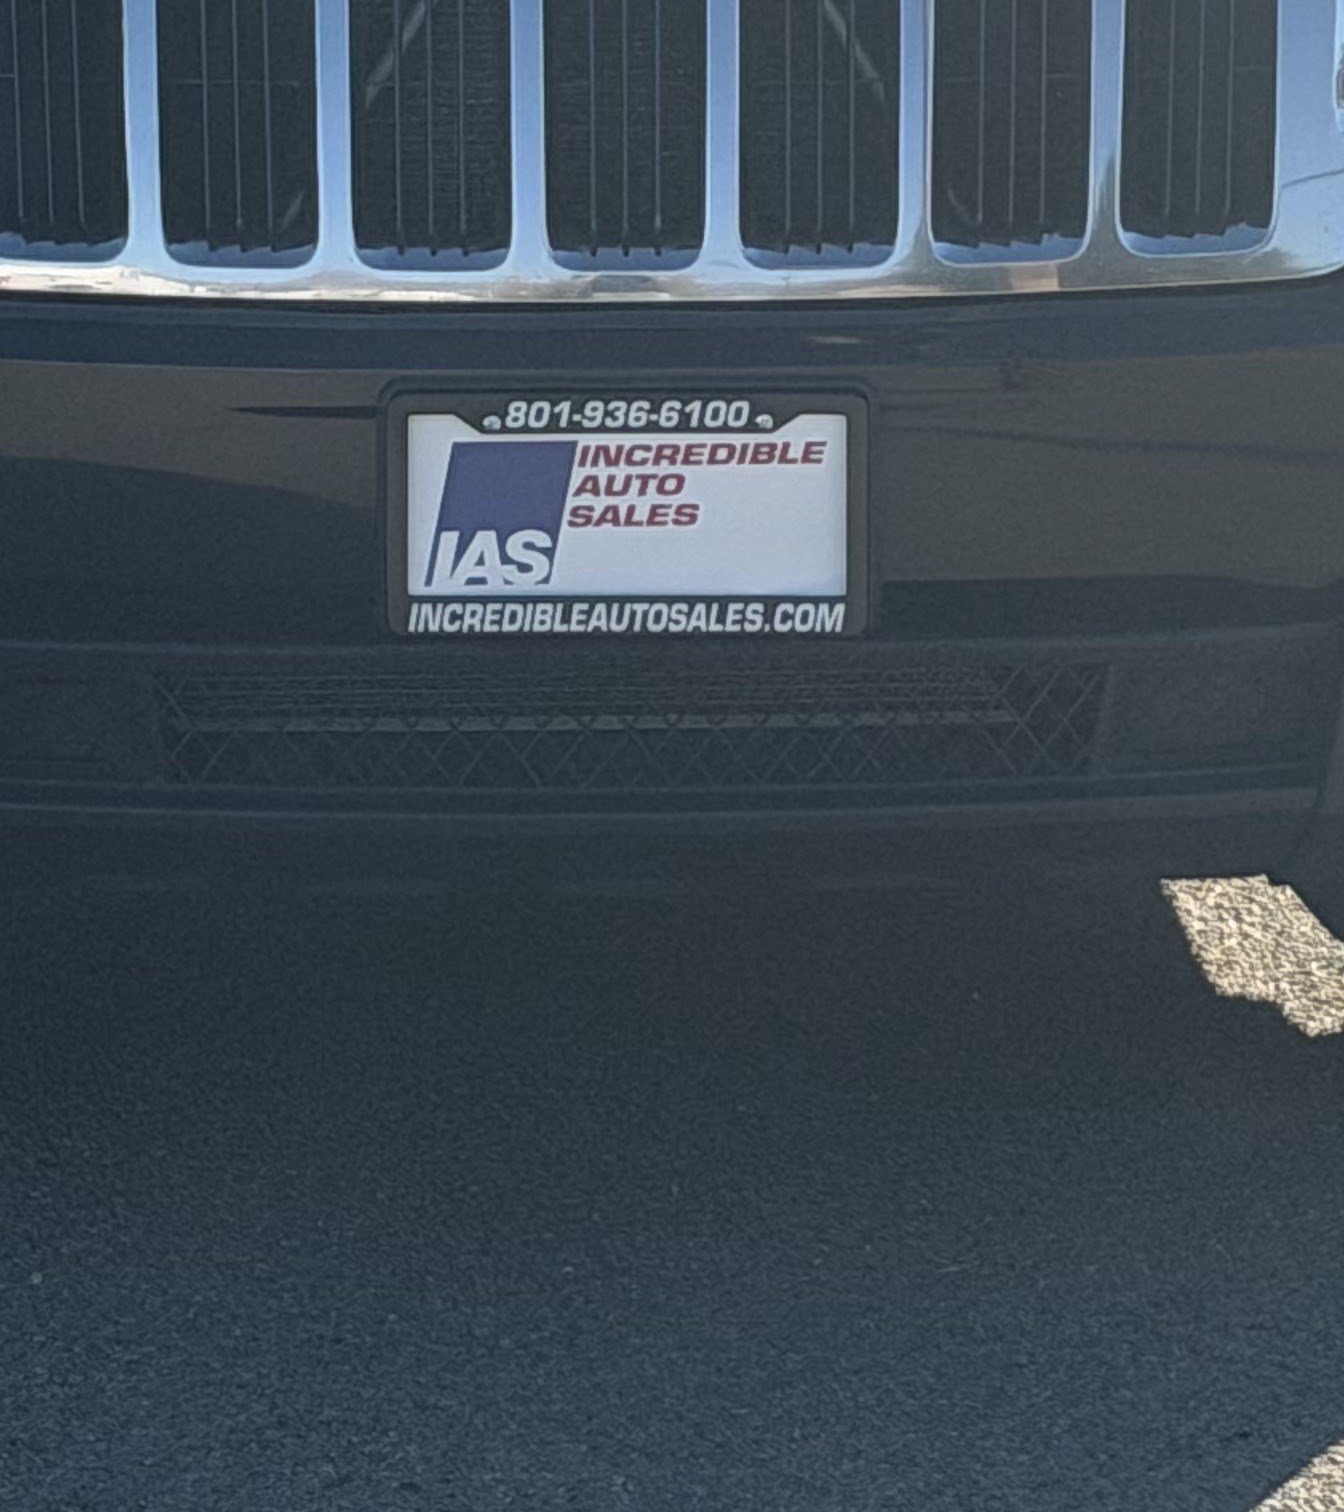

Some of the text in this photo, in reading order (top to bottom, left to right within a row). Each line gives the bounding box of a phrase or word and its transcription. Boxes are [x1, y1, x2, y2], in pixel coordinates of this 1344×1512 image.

[504, 400, 750, 429] 801-936-6100
[576, 441, 828, 468] INCREDIBLE
[572, 473, 686, 498] AUTO
[567, 502, 701, 528] SALES
[430, 528, 554, 587] IAS
[408, 601, 845, 634] INCREDIBLEAUTOSALES.COM
